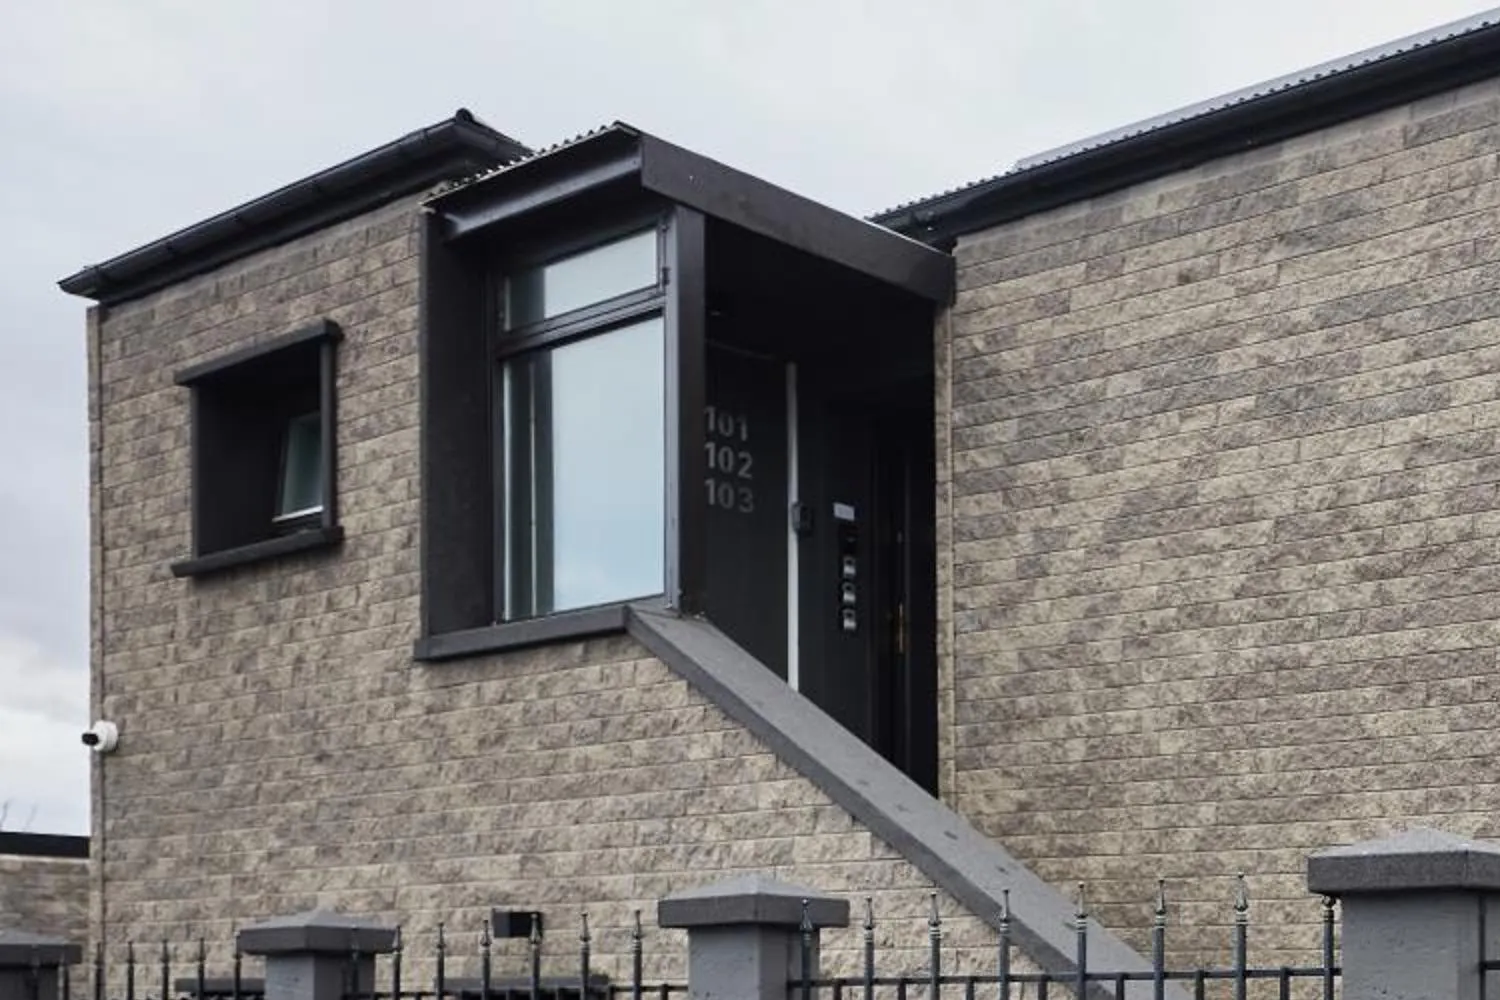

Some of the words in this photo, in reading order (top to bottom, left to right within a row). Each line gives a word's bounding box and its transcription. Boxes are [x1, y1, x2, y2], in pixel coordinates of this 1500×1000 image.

[703, 405, 749, 441] 101
[703, 441, 754, 480] 102
[703, 477, 755, 513] 103
